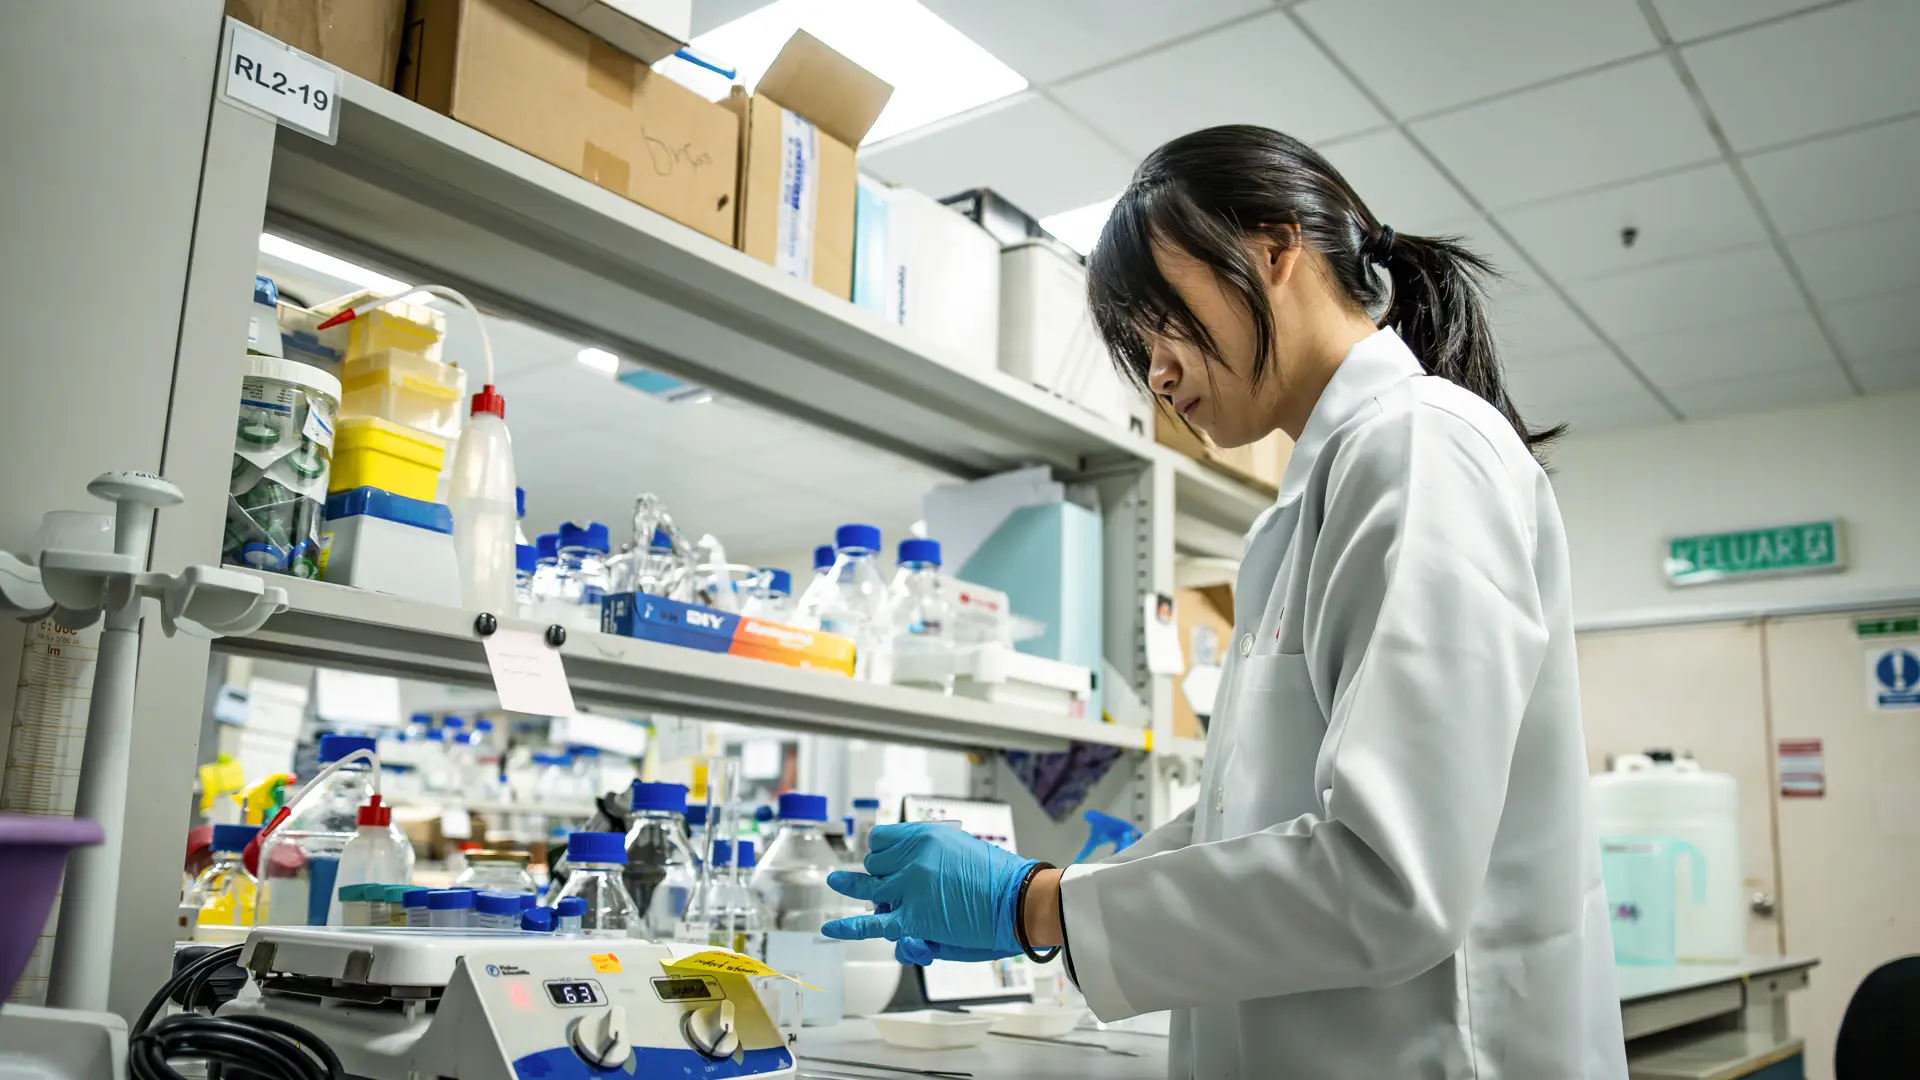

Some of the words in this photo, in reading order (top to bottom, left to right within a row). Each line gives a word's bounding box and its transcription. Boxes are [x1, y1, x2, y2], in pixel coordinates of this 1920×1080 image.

[234, 54, 328, 111] RL2-19
[686, 609, 725, 630] DIY
[563, 986, 592, 1003] 63
